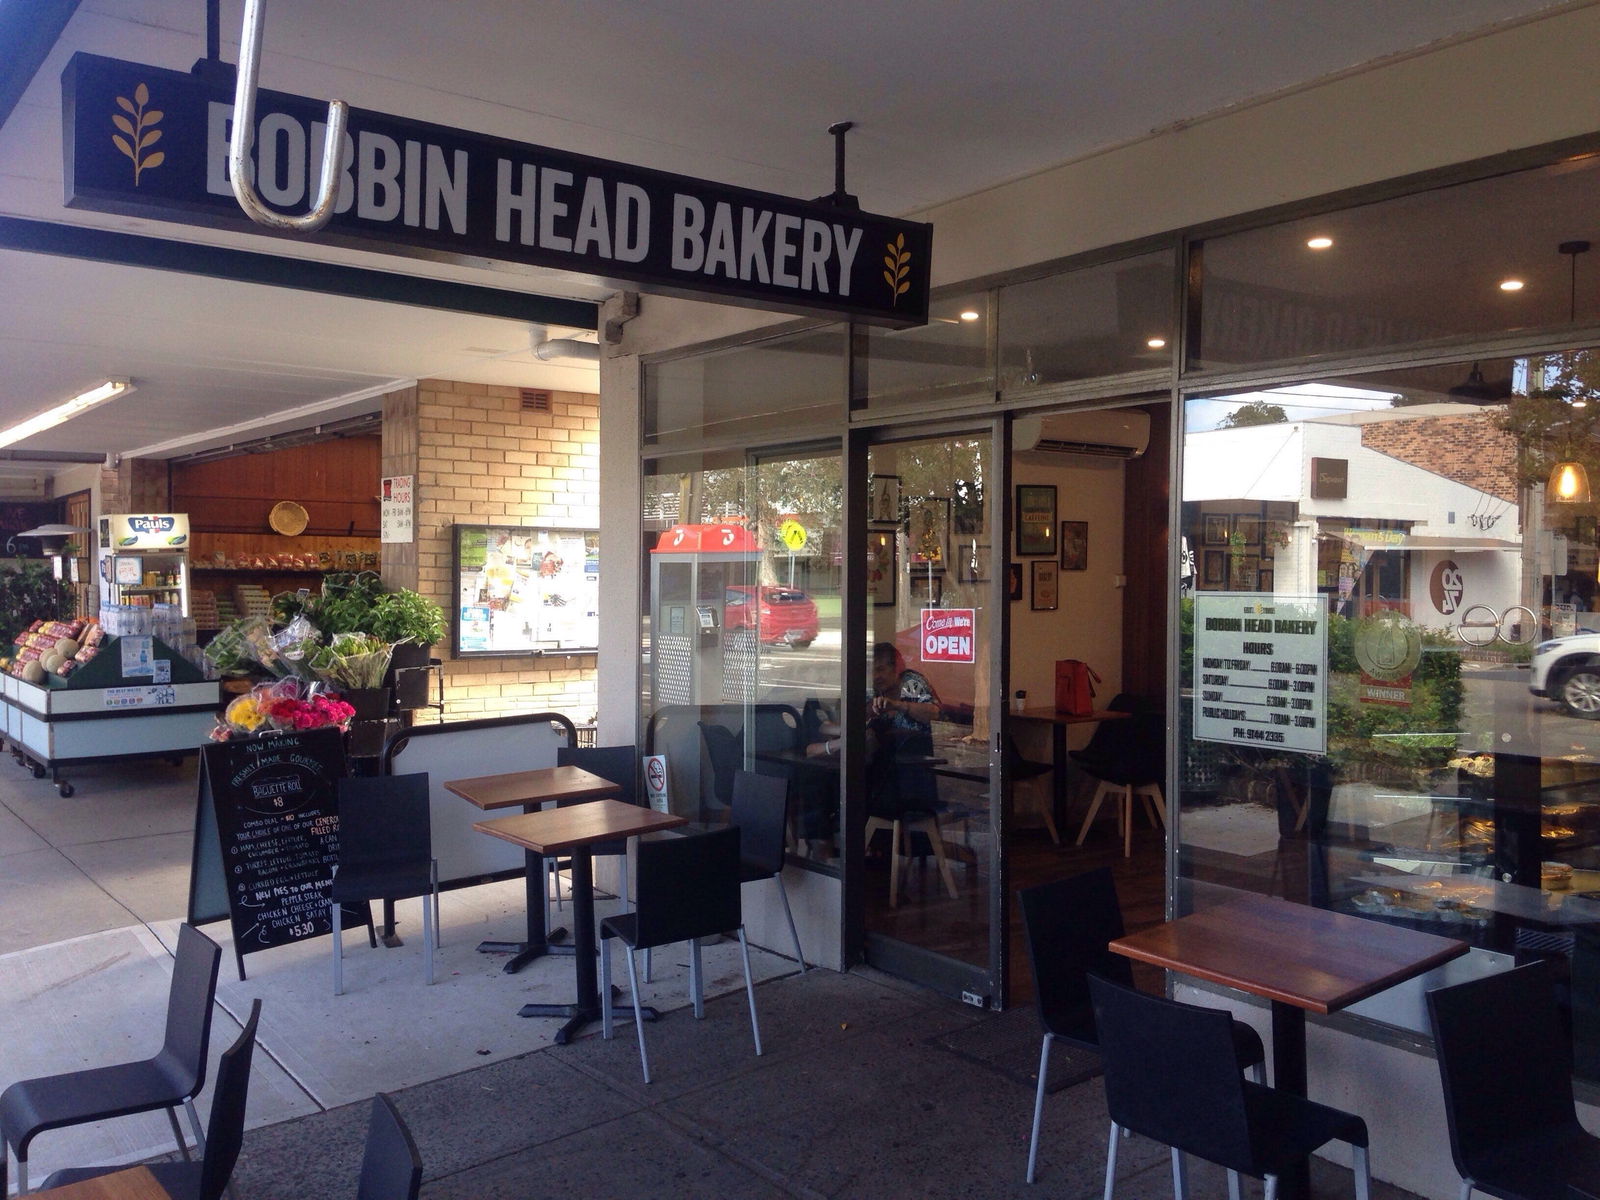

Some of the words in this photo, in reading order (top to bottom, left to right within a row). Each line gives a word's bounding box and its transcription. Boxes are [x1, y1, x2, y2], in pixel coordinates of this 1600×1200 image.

[206, 100, 469, 236] BOBBIN
[494, 157, 651, 264] HEAD
[670, 192, 864, 297] BAKERY
[393, 491, 411, 503] HOURS
[134, 518, 170, 529] Pauls
[926, 615, 946, 631] Come
[1205, 617, 1242, 632] BOBBIN
[1244, 618, 1273, 633] HEAD
[1274, 619, 1317, 635] BAKERY
[925, 635, 971, 656] OPEN
[1243, 641, 1274, 655] HOURS
[1366, 687, 1406, 700] WINNER
[1265, 731, 1285, 743] 2335
[245, 742, 265, 753] NOW
[267, 737, 301, 750] MAKING
[260, 754, 281, 766] MADE
[252, 782, 287, 798] BAGUETTE
[287, 779, 303, 791] ROLL
[273, 796, 284, 807] $8
[243, 819, 264, 829] COMBO
[264, 816, 279, 826] DEAL
[236, 830, 250, 840] YOUR
[310, 825, 331, 836] FILLED
[294, 869, 319, 880] LETTUCE
[255, 890, 271, 901] NEW
[273, 885, 289, 897] PIES
[300, 881, 314, 892] OUR
[303, 890, 325, 901] STEAK
[257, 908, 288, 921] CHICKEN
[290, 900, 314, 914] CHEESE
[271, 914, 300, 929] CHICKEN
[306, 908, 327, 920] SATAY
